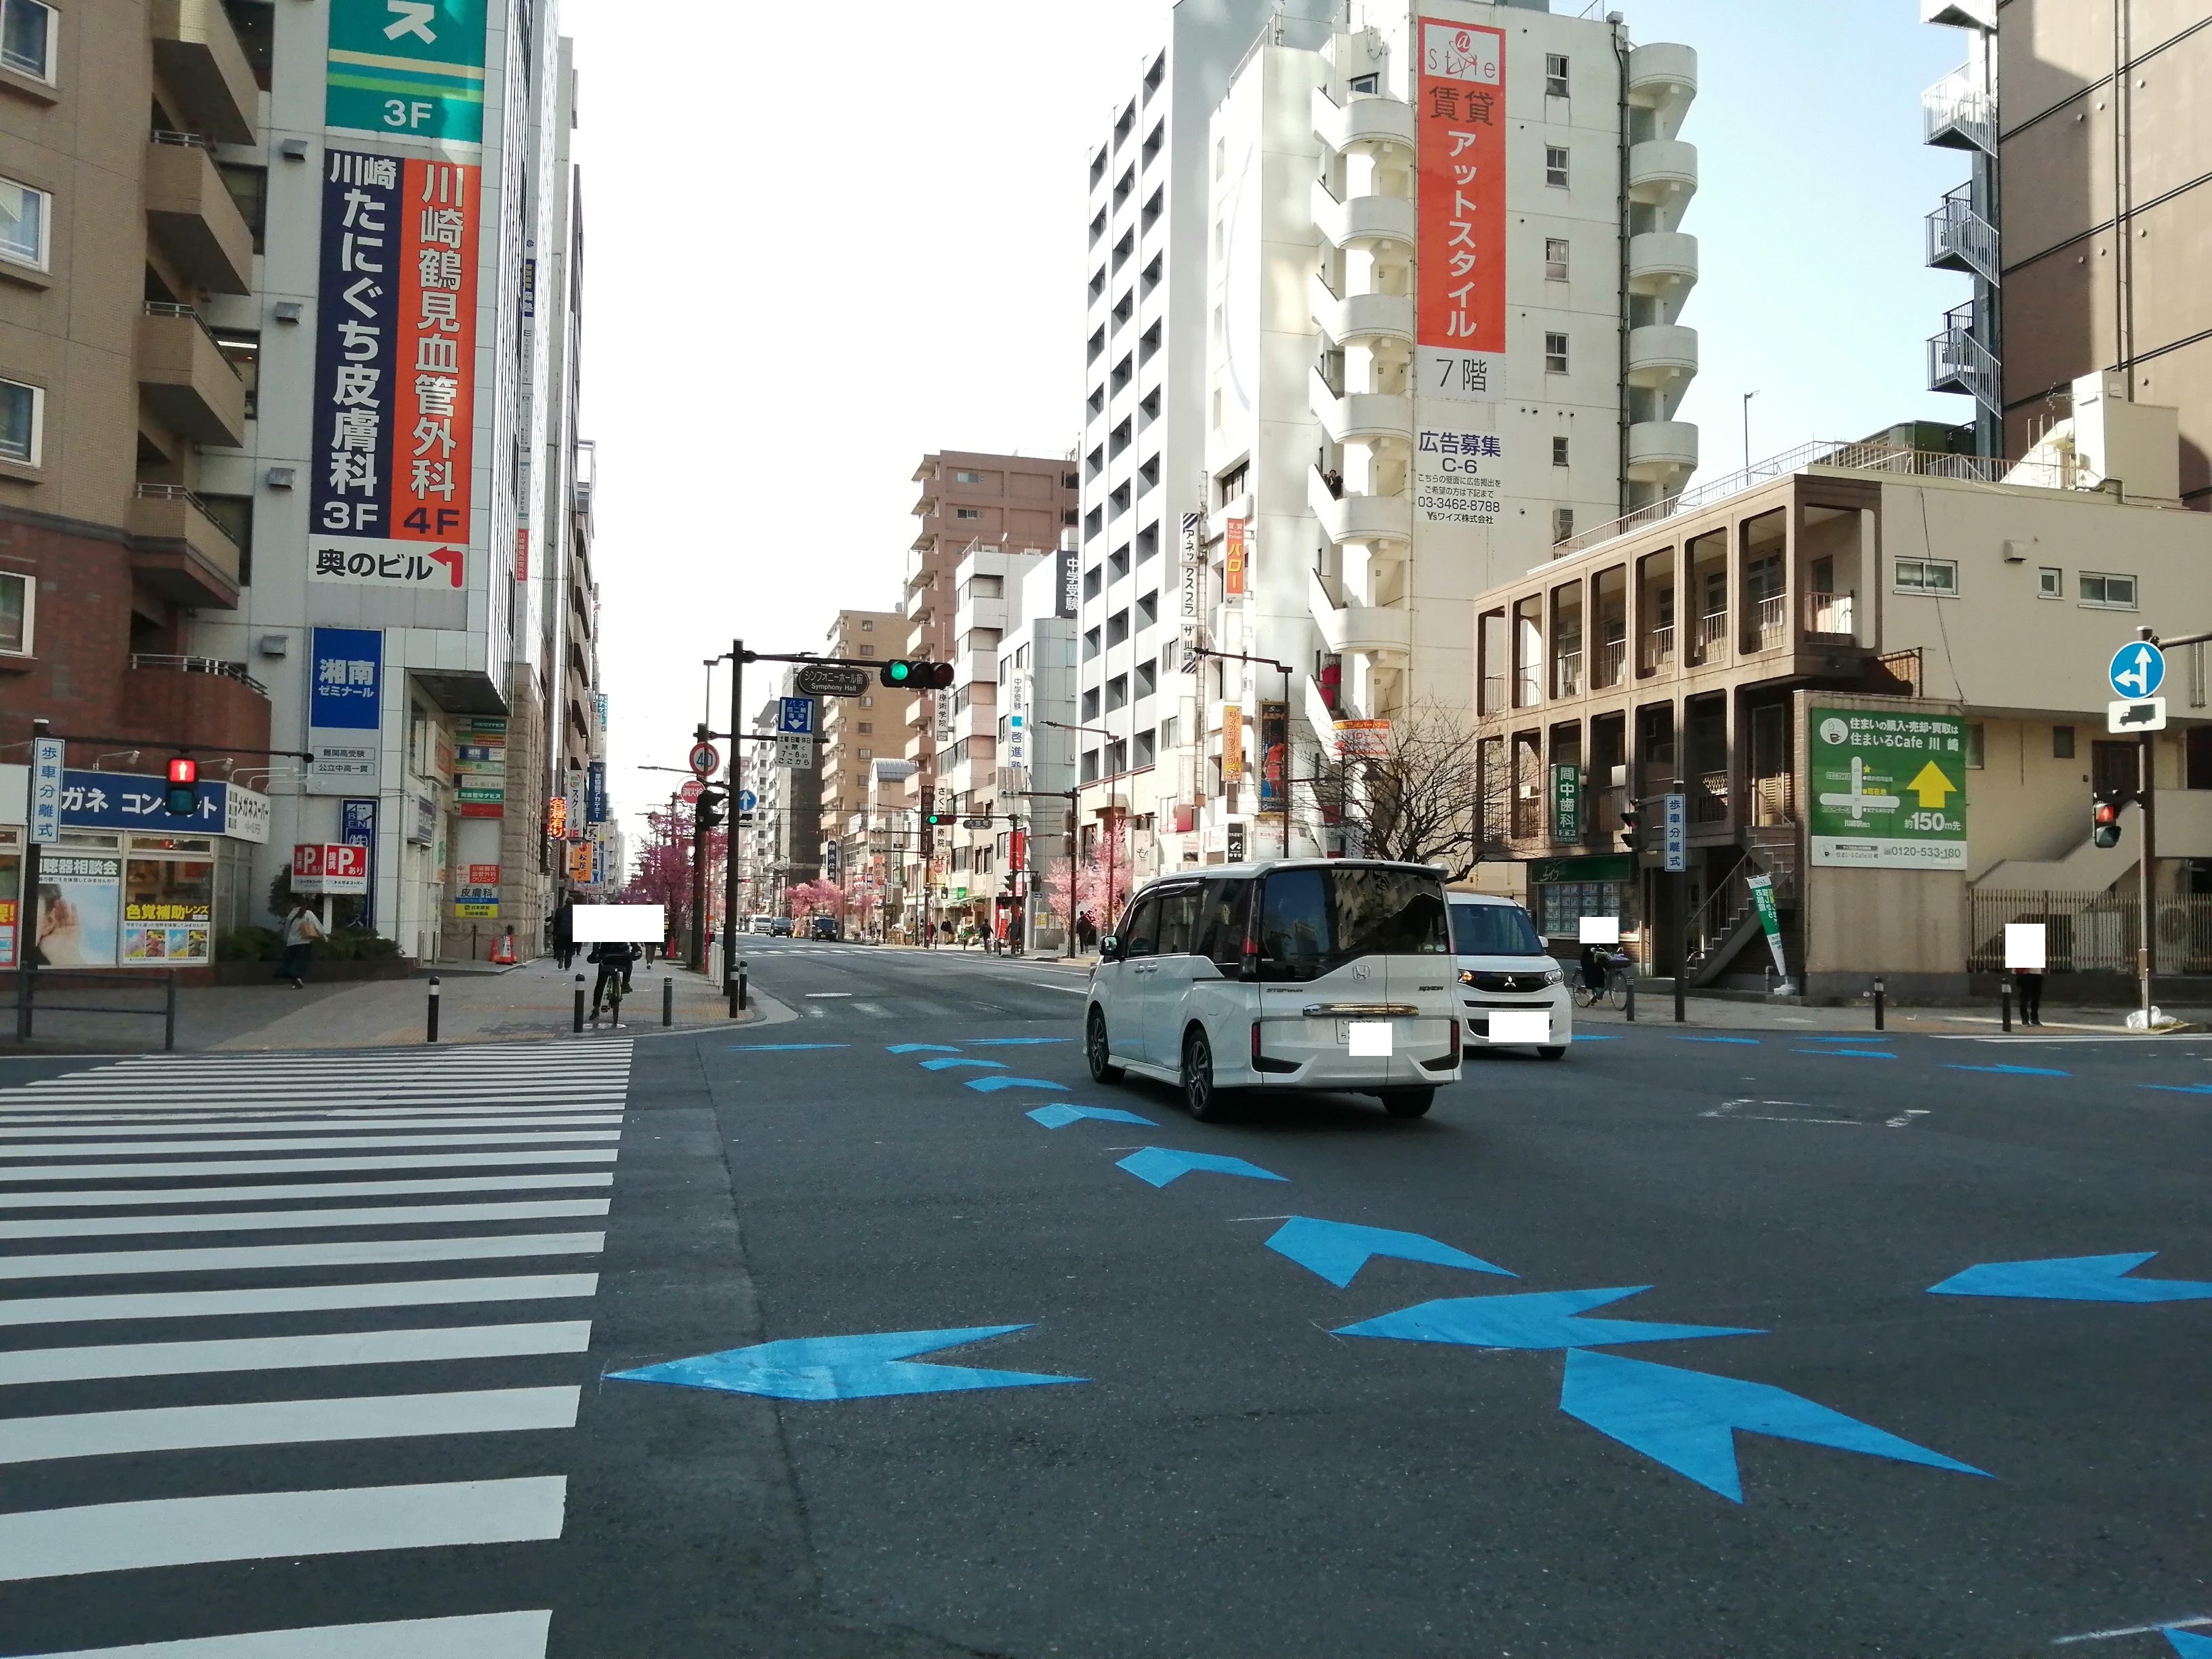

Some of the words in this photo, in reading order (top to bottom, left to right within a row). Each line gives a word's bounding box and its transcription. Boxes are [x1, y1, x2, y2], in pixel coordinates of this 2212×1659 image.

[384, 0, 437, 44] ス
[384, 99, 432, 128] 3F
[1429, 85, 1495, 127] 賃貸
[330, 153, 396, 190] 川崎
[1446, 130, 1477, 337] アットスタイル
[329, 188, 386, 497] たにぐち皮膚科
[411, 163, 464, 501] 川崎鶴見血管外科
[1436, 359, 1487, 392] 7階
[1418, 431, 1501, 457] 広告募集
[1442, 457, 1477, 474] C-6
[1418, 474, 1501, 487] こちらの壁面に広告掲出を
[1425, 486, 1494, 498] ご希望の方は下記まで
[323, 501, 377, 531] 3F
[1418, 496, 1500, 512] 03-3462-8788
[403, 508, 460, 535] 4F
[316, 550, 433, 581] 奥のビル
[1066, 557, 1078, 610] 中学受験
[319, 659, 375, 685] 湘南
[804, 670, 863, 684] シンフォニーホール前
[319, 685, 374, 698] ゼミナール
[1014, 678, 1022, 710] 中学受験
[939, 689, 947, 727] 療術学院
[323, 749, 365, 758] 難関高受験
[319, 764, 368, 773] 公立中高一貫
[38, 747, 57, 837] 歩車分離式
[122, 792, 218, 819] コント
[1559, 767, 1575, 828] 間中歯科
[571, 789, 579, 828] スクール
[1669, 800, 1681, 867] 歩車分離式
[304, 847, 316, 873] P
[338, 848, 354, 874] P
[579, 855, 587, 869] 松屋
[1891, 846, 1961, 858] 0120-533-180
[39, 859, 117, 876] 聴器相談会
[348, 867, 363, 875] あり
[461, 888, 493, 897] 皮膚科
[126, 904, 186, 920] 色覚補助
[186, 905, 209, 914] レンズ
